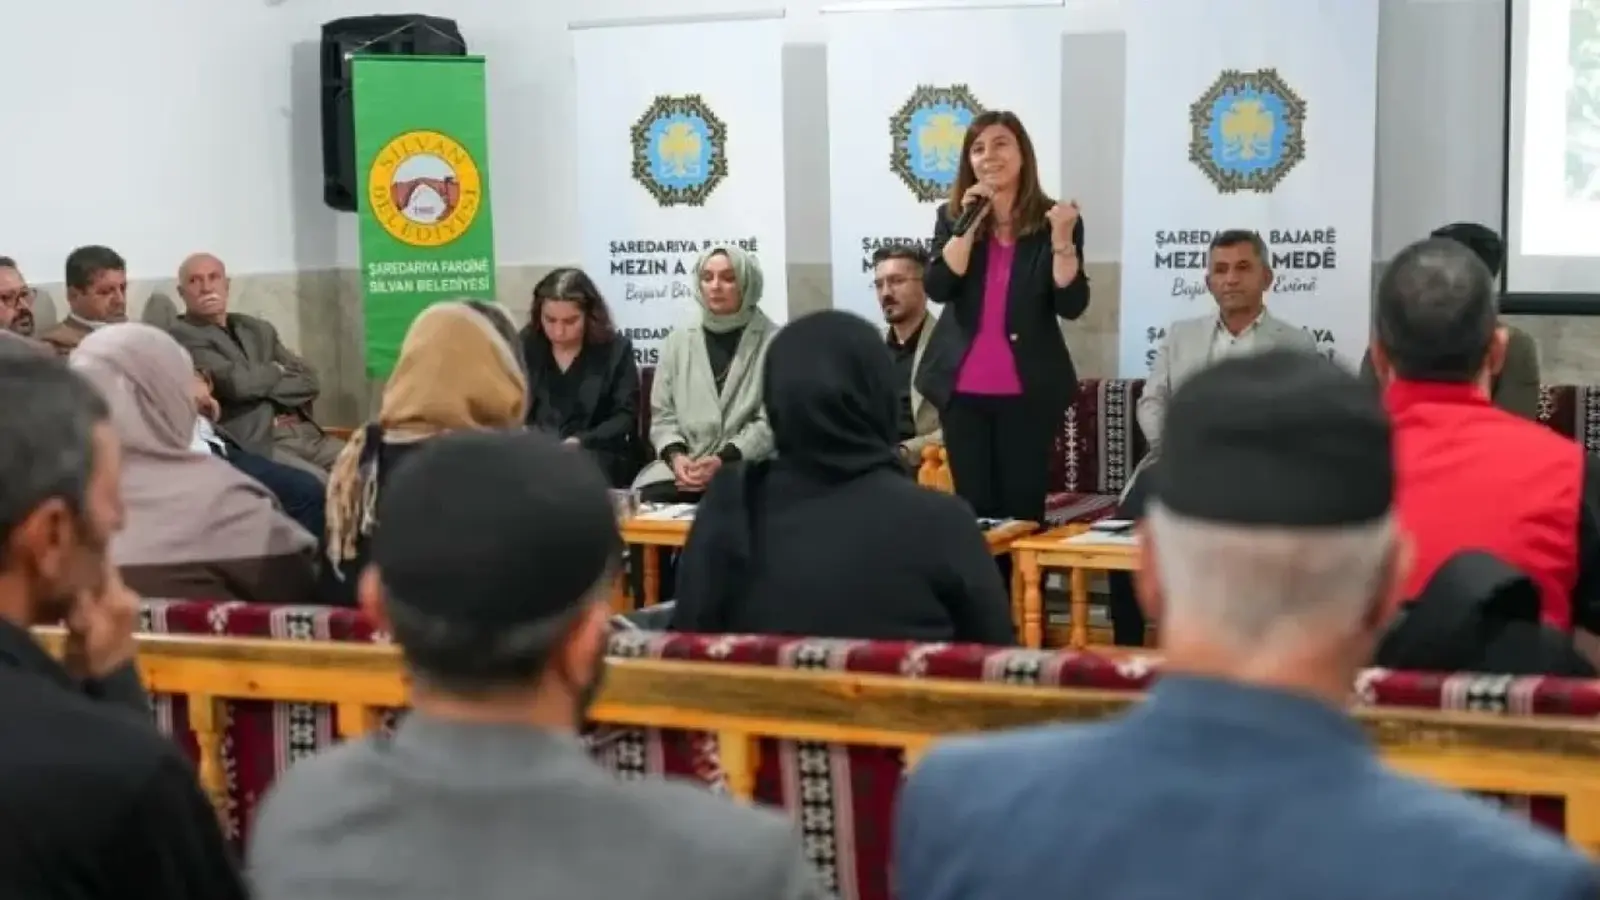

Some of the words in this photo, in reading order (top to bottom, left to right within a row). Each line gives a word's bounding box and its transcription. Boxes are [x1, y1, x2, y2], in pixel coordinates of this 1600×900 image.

[1269, 227, 1336, 244] BAJARÊ
[609, 239, 699, 256] ŞAREDARIYA
[703, 235, 758, 250] BRÊ
[610, 259, 667, 275] MEZIN
[674, 260, 687, 275] A
[1155, 251, 1206, 268] MEZI
[1272, 247, 1336, 269] MEDÊ
